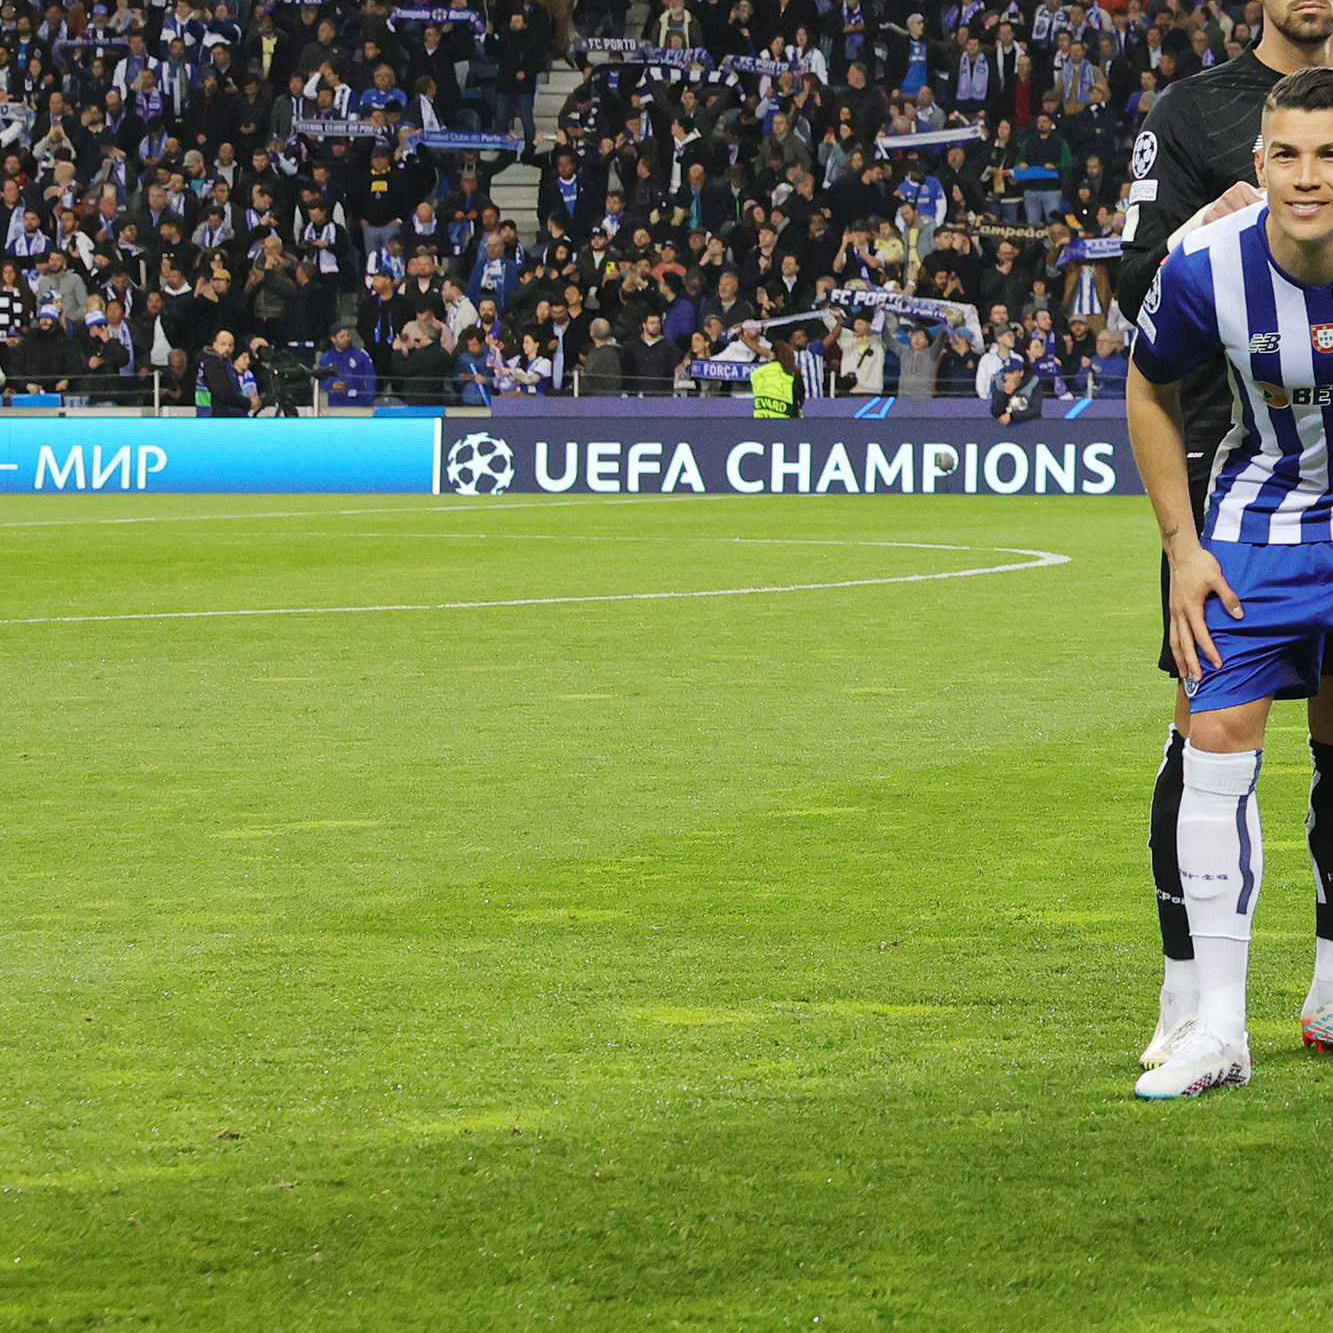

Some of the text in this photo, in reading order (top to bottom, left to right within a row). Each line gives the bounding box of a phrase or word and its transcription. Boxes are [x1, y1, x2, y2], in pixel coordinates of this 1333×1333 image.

[587, 37, 638, 51] FC PORTO
[979, 223, 1049, 240] ampeão
[830, 291, 851, 304] FC
[703, 361, 739, 380] FORÇA
[33, 443, 169, 491] МИР
[534, 440, 1118, 494] UEFA CHAMPIONS
